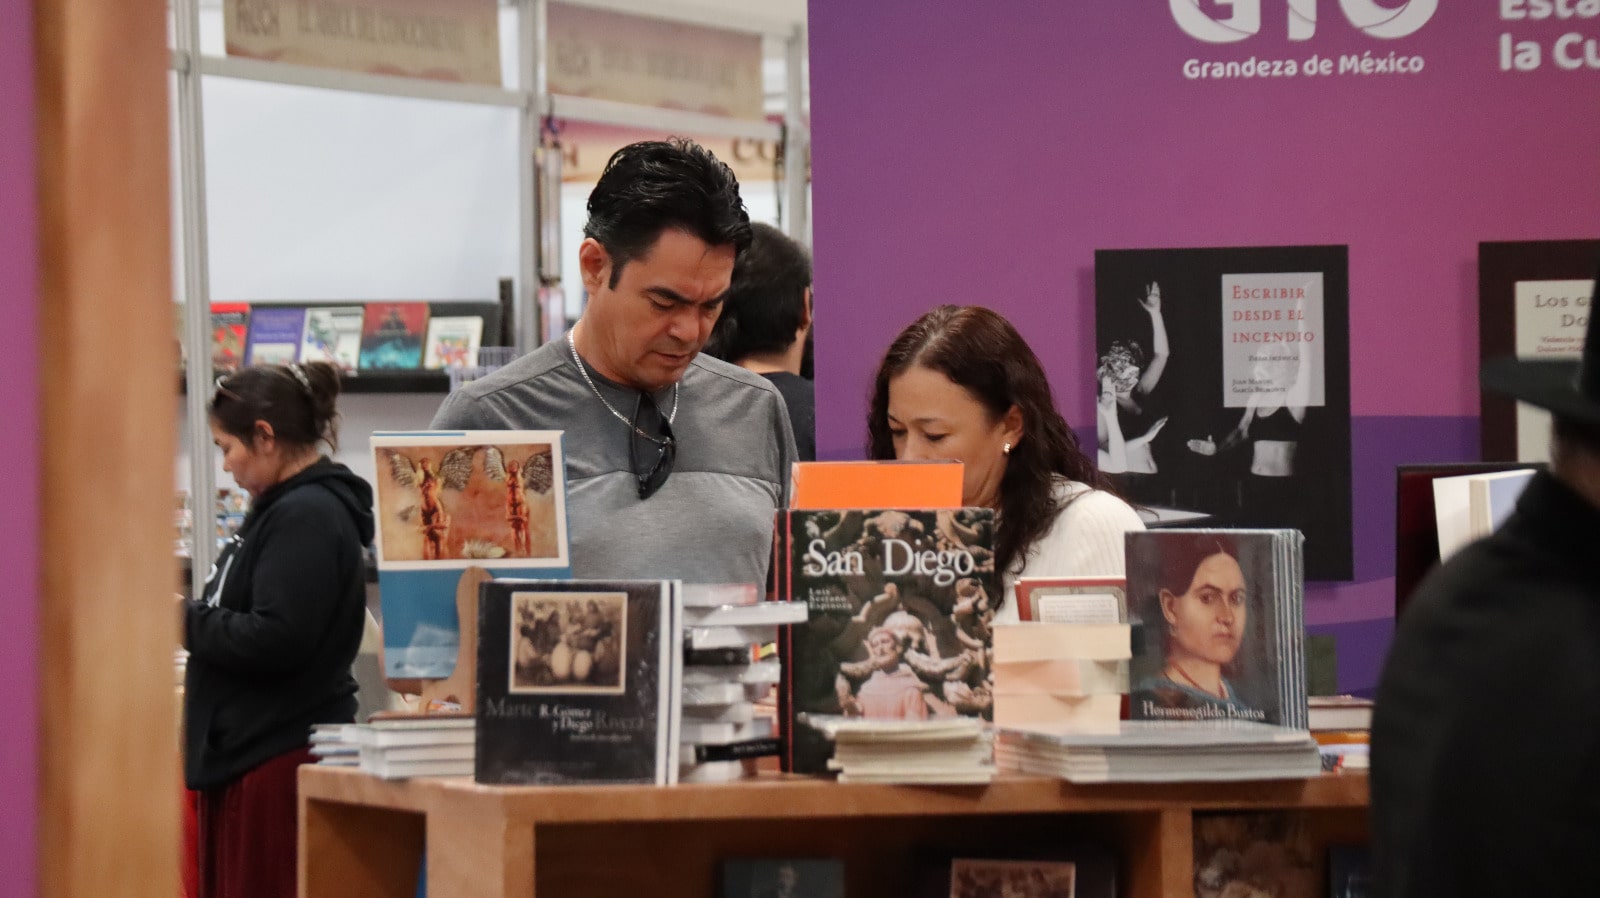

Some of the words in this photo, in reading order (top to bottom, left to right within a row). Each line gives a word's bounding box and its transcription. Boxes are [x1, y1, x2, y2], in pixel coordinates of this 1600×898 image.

[1501, 32, 1541, 71] la
[1183, 56, 1298, 79] Grandeza
[1303, 54, 1333, 76] de
[1338, 50, 1425, 75] México
[1232, 310, 1282, 321] DESDE
[1287, 309, 1304, 320] EL
[1232, 331, 1315, 343] INCENDIO
[808, 538, 866, 577] San
[882, 538, 975, 587] Diego
[1142, 700, 1226, 719] Hermenegildo
[1227, 702, 1266, 720] Bustos
[560, 717, 593, 733] Diego
